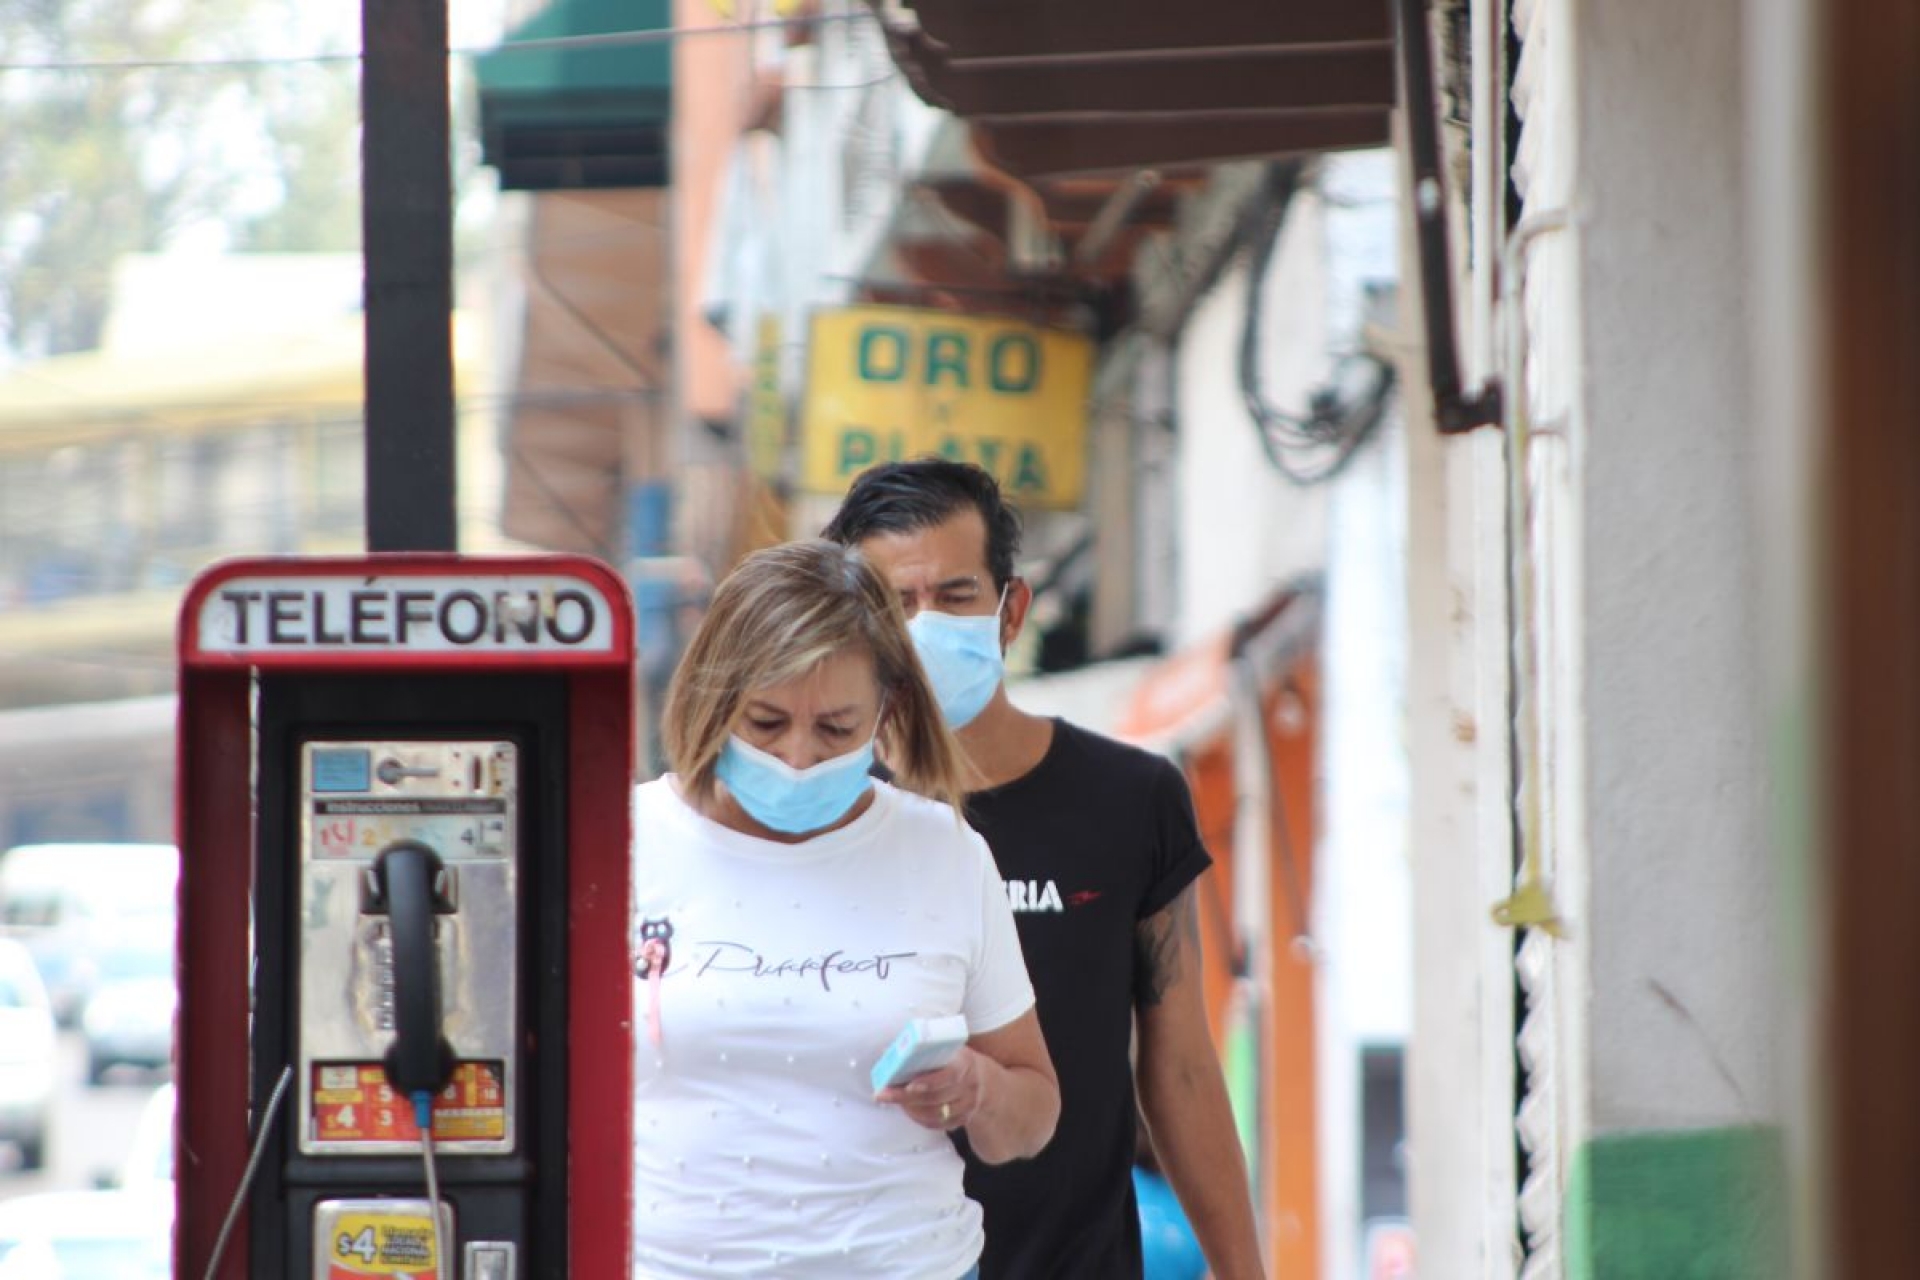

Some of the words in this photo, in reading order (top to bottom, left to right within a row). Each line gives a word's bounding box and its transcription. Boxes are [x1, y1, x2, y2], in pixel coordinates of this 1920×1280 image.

[857, 326, 1042, 393] ORO
[221, 575, 596, 646] TELÉFONO
[338, 1226, 377, 1264] $4
